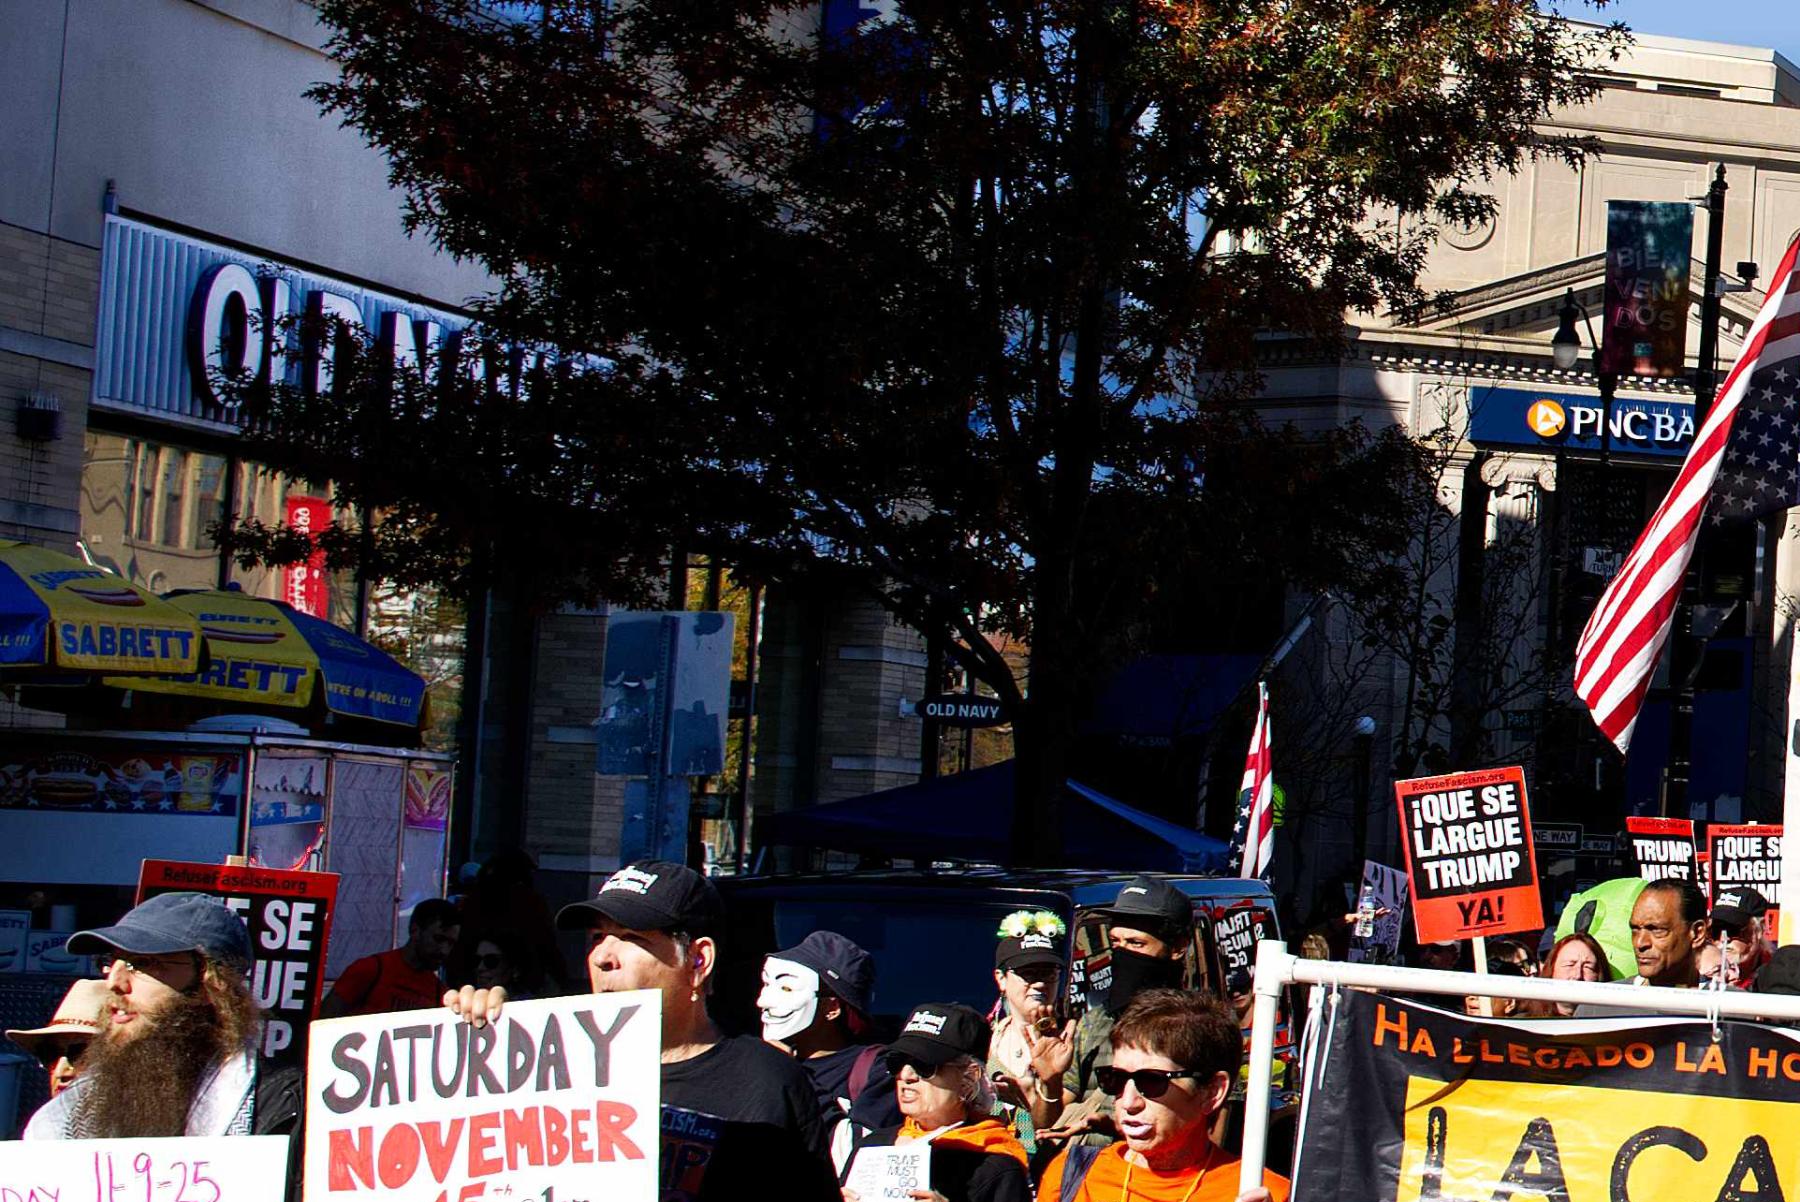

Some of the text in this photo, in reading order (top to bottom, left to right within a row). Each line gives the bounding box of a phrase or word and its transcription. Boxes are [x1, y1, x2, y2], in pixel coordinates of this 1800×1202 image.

[1570, 406, 1695, 442] PNC BA
[60, 623, 195, 660] SABRETT
[926, 703, 1000, 719] OLD NAVY
[1411, 773, 1506, 792] RefuseFascism.org
[1411, 783, 1518, 829] ¡QUE SE
[1413, 816, 1523, 859] LARGUE
[1533, 830, 1575, 842] NE WAY
[1632, 838, 1693, 863] TRUMP
[1716, 836, 1763, 860] ¡QUE
[1422, 850, 1521, 891] TRUMP
[1640, 863, 1690, 882] MUST
[1715, 859, 1783, 881] LARGU
[260, 899, 317, 951] SE
[1456, 895, 1506, 928] YA!
[1373, 1002, 1438, 1059] HA
[1674, 1041, 1728, 1076] LA
[321, 1004, 642, 1114] SATURDAY
[327, 1100, 646, 1192] NOVEMBER
